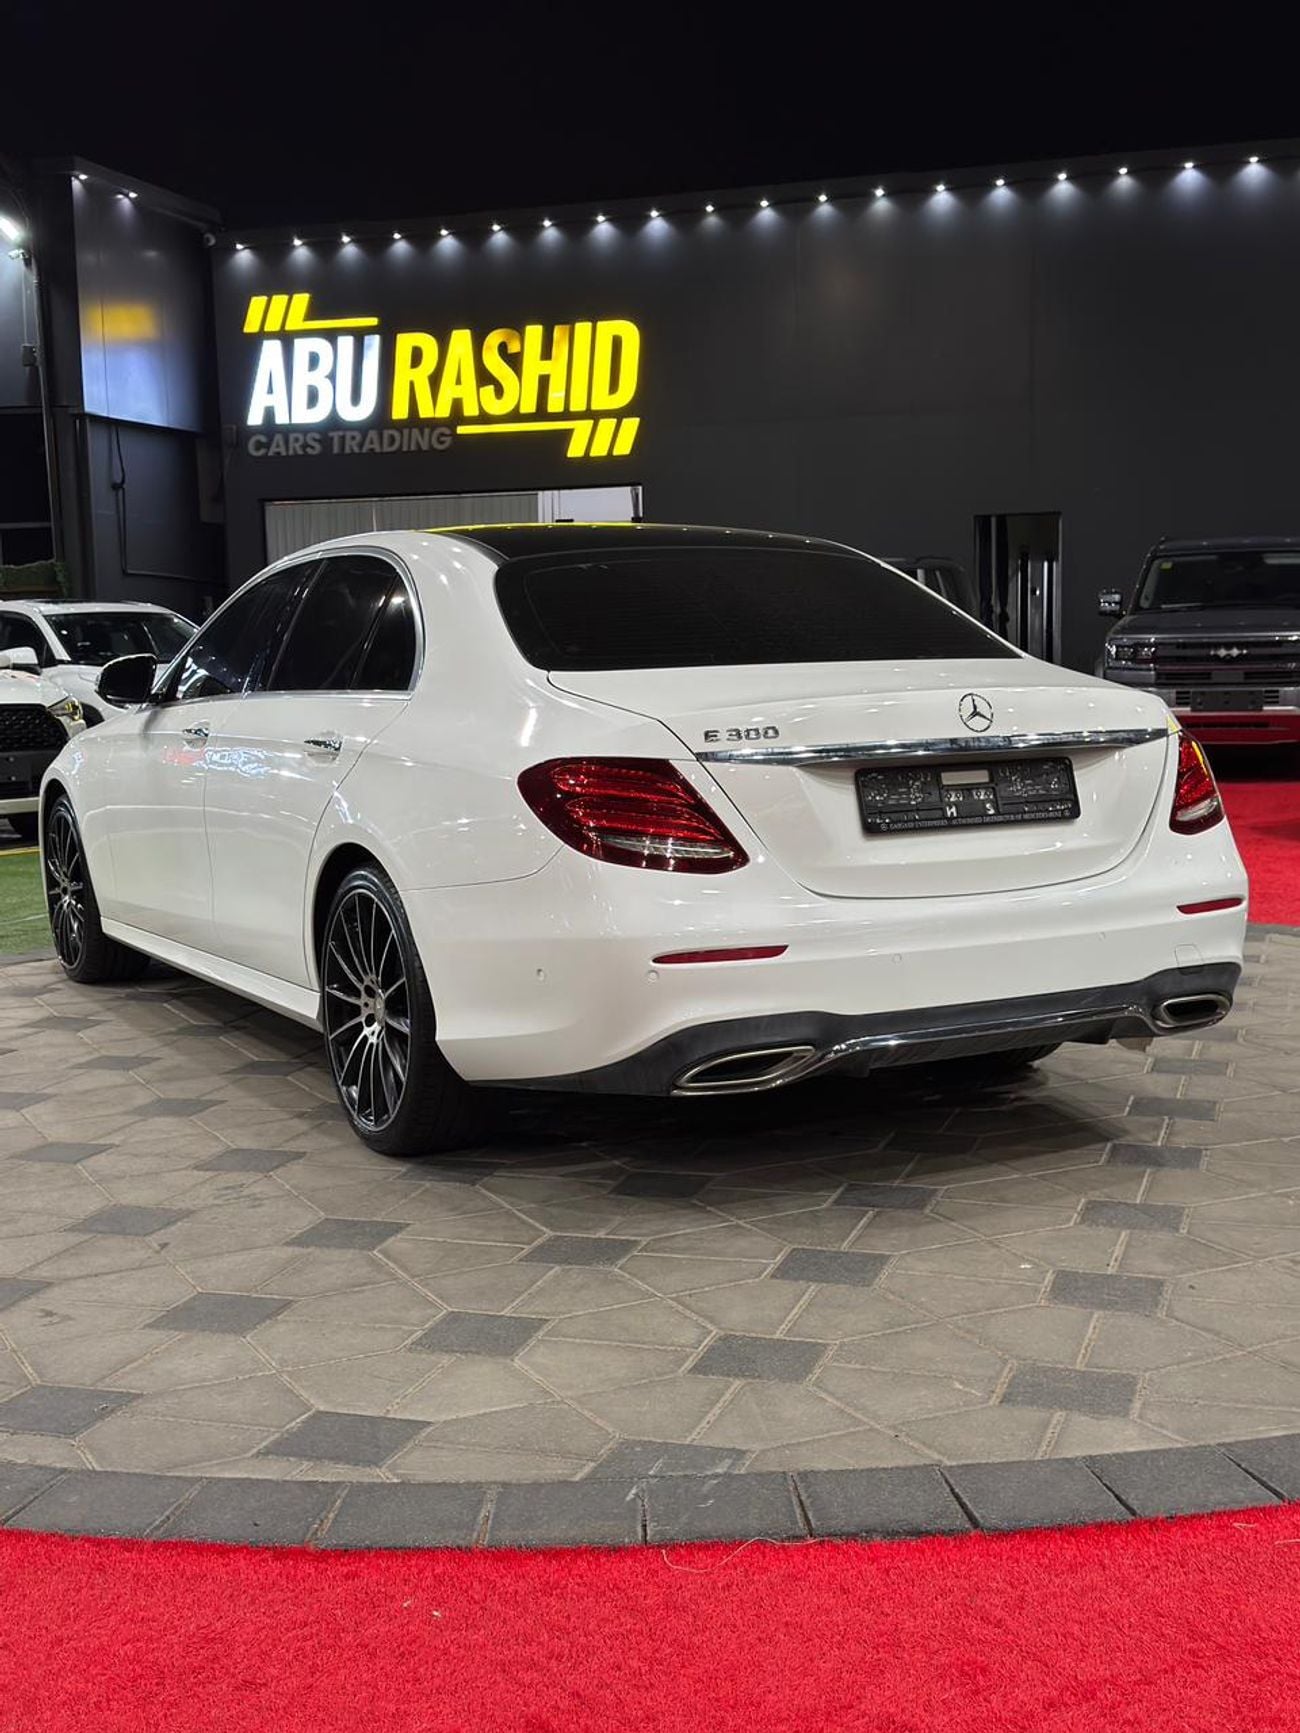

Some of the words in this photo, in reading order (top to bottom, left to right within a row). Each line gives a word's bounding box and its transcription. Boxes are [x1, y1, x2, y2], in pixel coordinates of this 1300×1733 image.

[247, 334, 381, 425] ABU
[391, 319, 641, 420] RASHID
[247, 431, 321, 457] CARS
[328, 426, 453, 454] TRADING
[703, 729, 721, 743] E
[725, 725, 780, 742] 300
